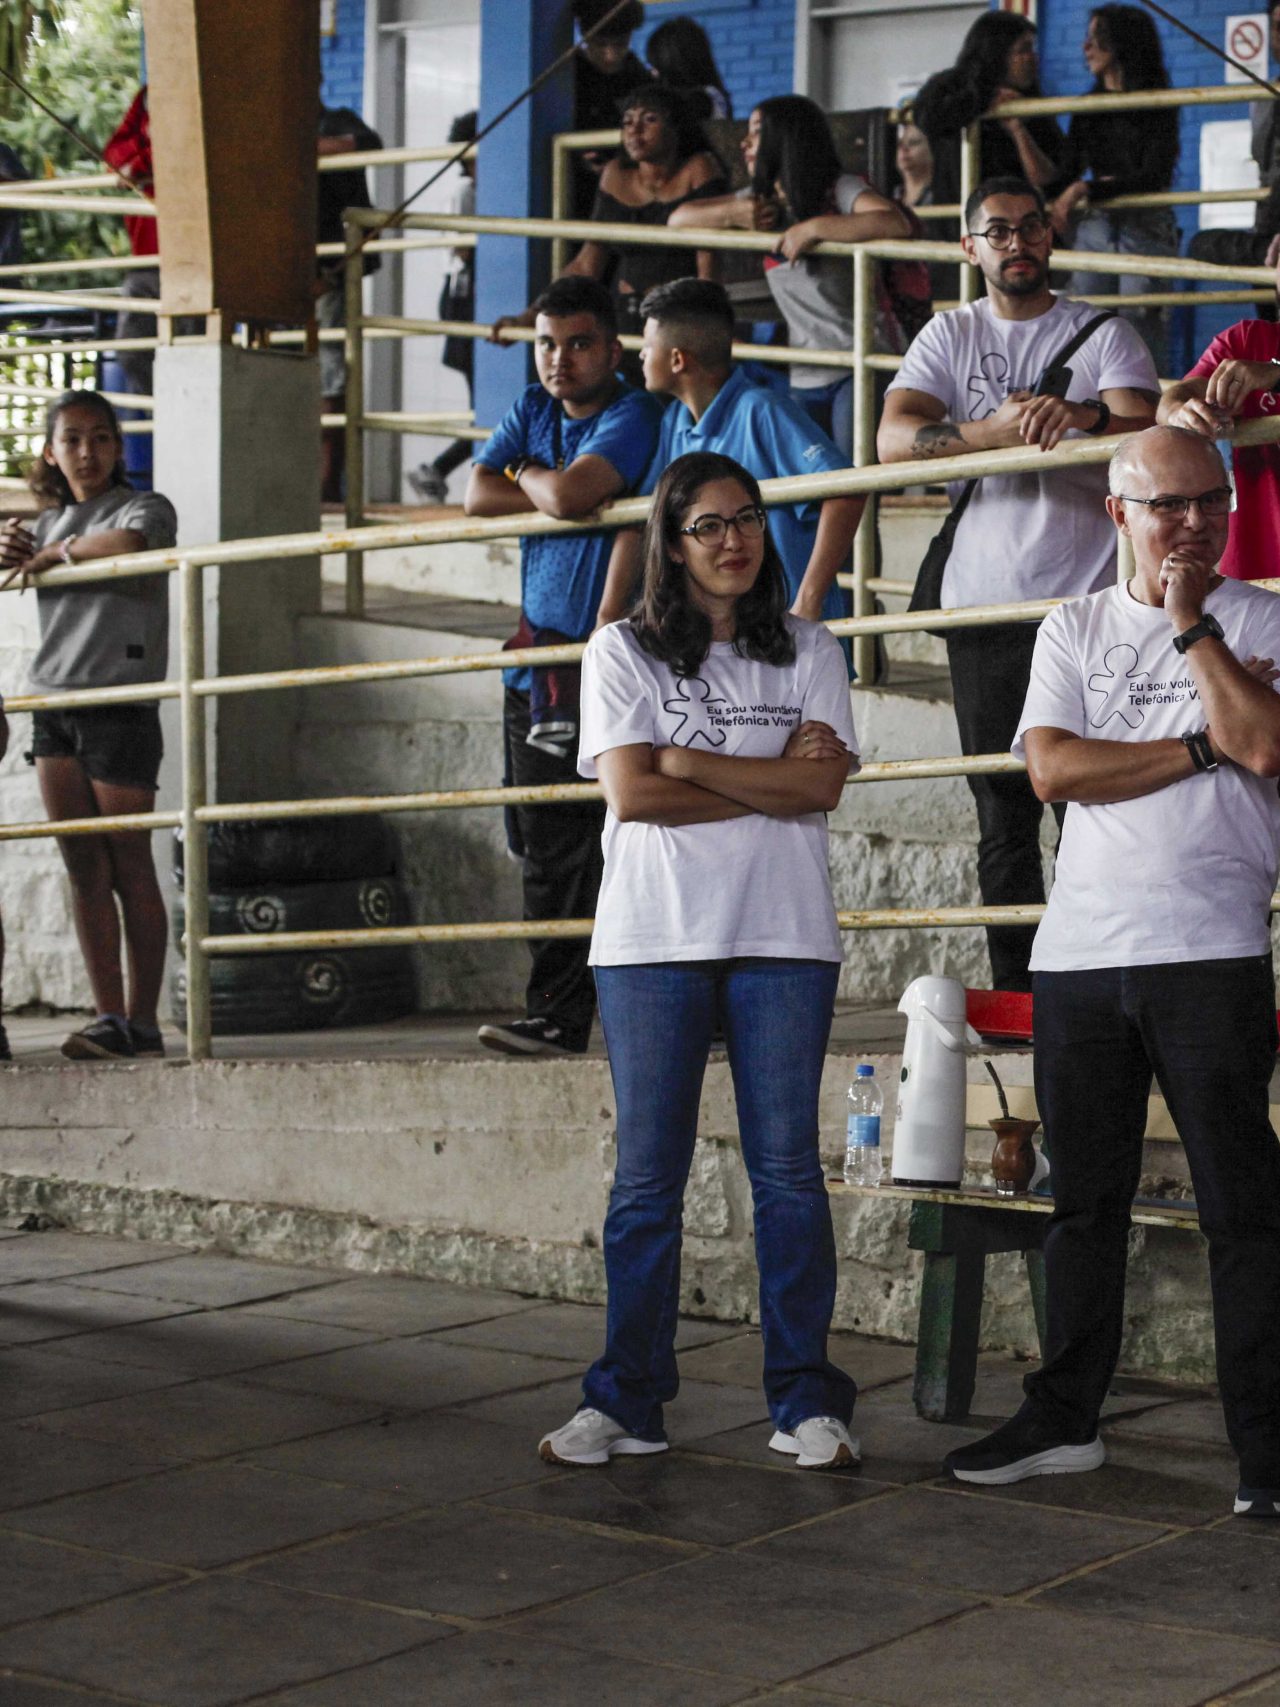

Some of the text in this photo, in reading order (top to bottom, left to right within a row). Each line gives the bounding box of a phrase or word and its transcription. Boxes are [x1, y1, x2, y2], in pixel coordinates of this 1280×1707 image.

[1129, 682, 1144, 692] Eu
[1147, 682, 1167, 691] sou
[1128, 692, 1185, 706] Telefônica
[707, 705, 722, 715] Eu
[726, 704, 747, 714] sou
[708, 715, 793, 727] Telefônica Vivo
